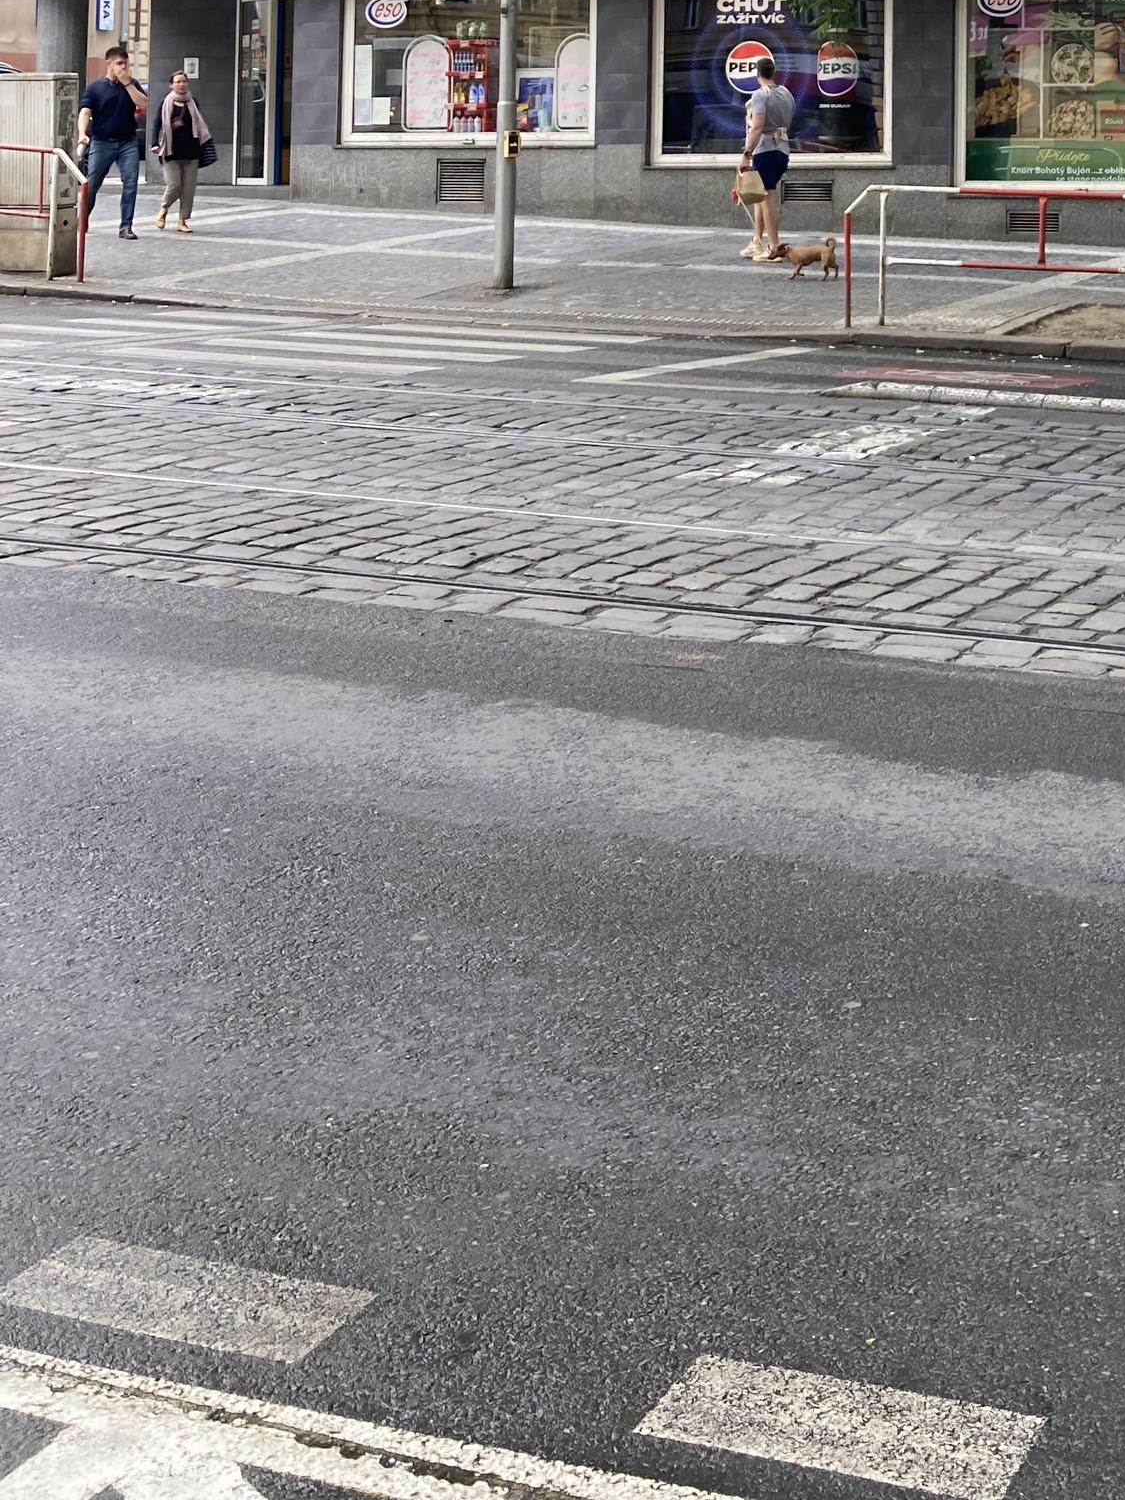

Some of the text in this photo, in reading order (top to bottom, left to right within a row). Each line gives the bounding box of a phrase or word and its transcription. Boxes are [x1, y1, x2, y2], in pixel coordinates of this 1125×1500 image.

[375, 2, 402, 18] eso
[716, 12, 786, 24] ZAŽÍT VÍC
[729, 62, 758, 73] PEP
[818, 63, 857, 74] PEPSI
